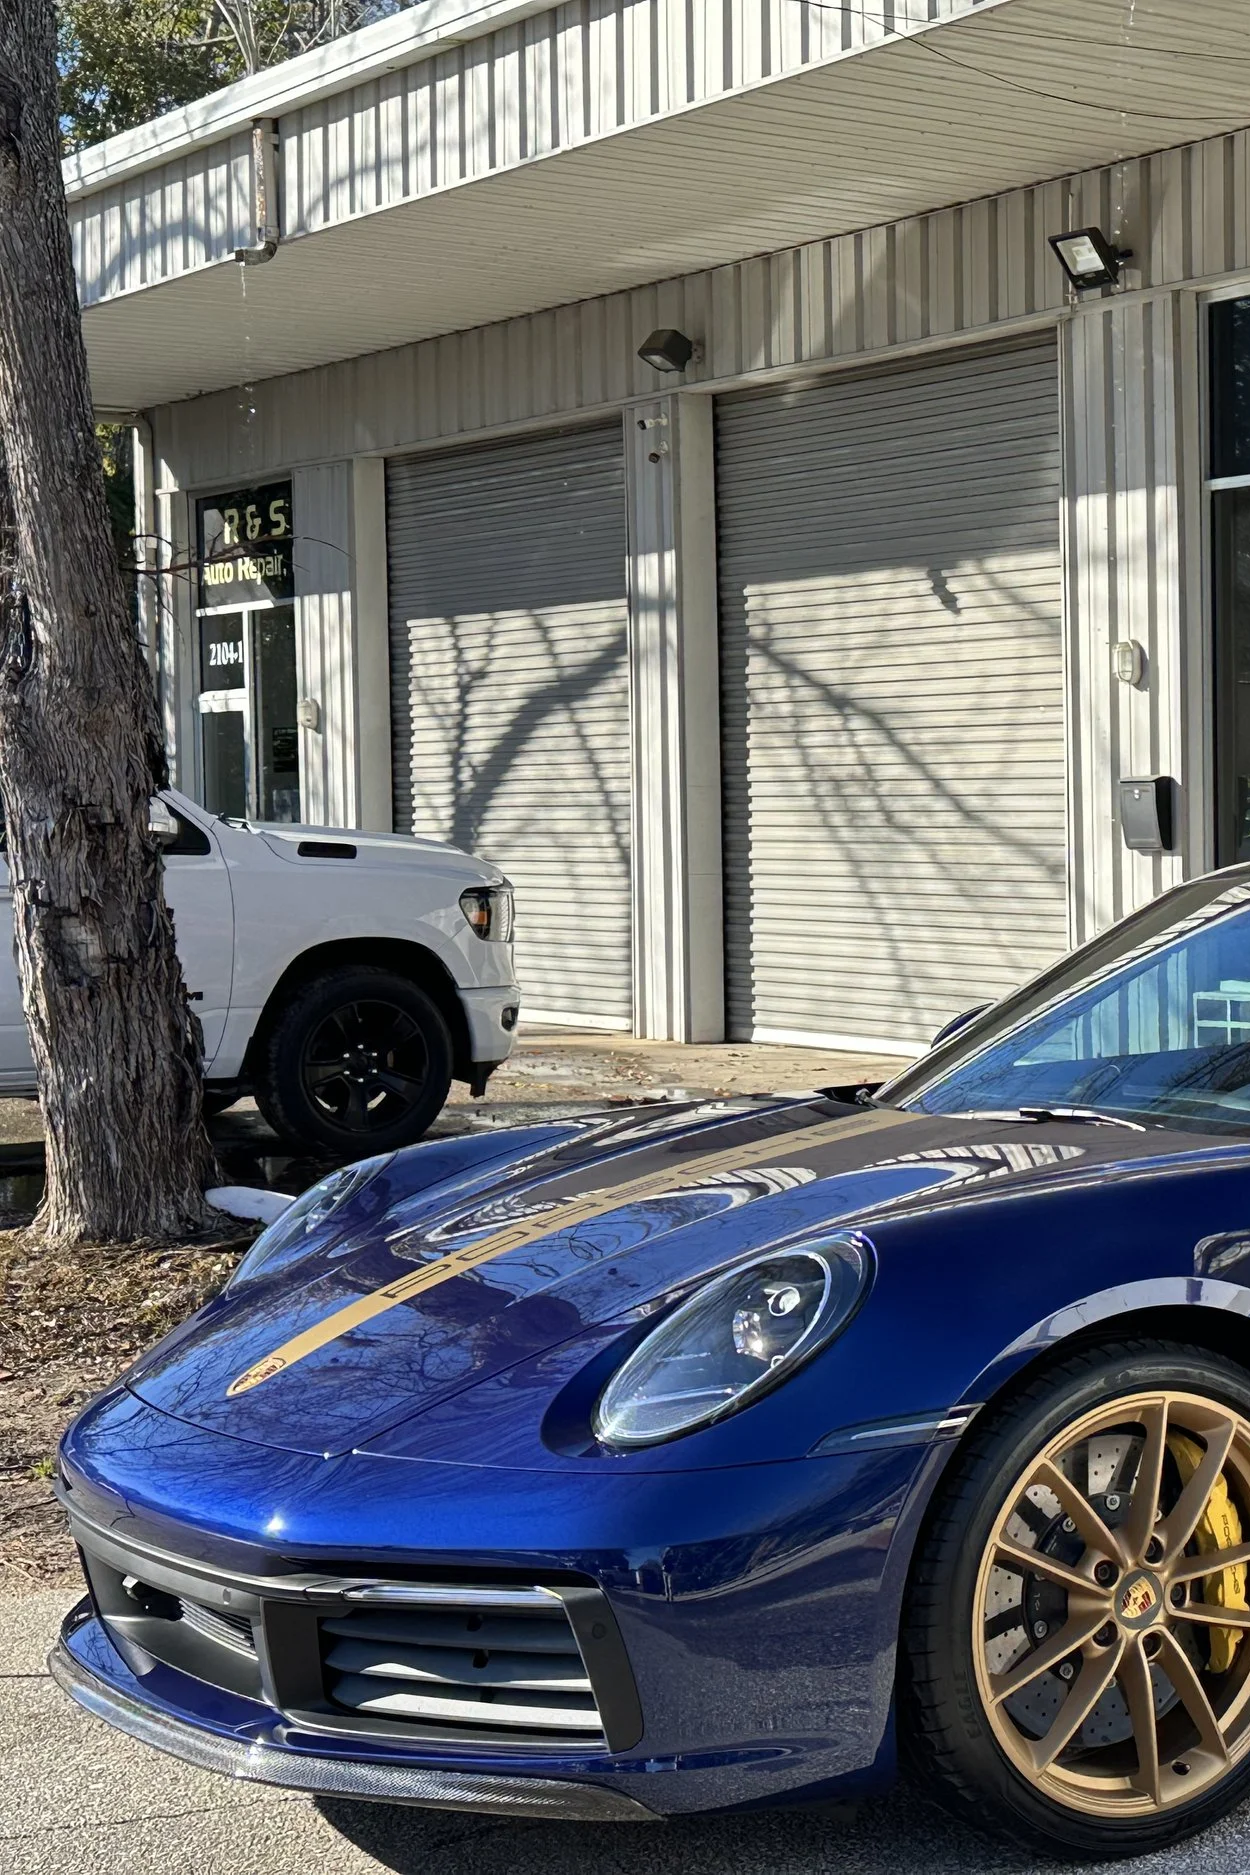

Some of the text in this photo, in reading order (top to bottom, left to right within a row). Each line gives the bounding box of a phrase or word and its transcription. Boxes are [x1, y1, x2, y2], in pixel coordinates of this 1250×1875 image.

[223, 499, 286, 545] R & S
[208, 640, 244, 666] 2104-1
